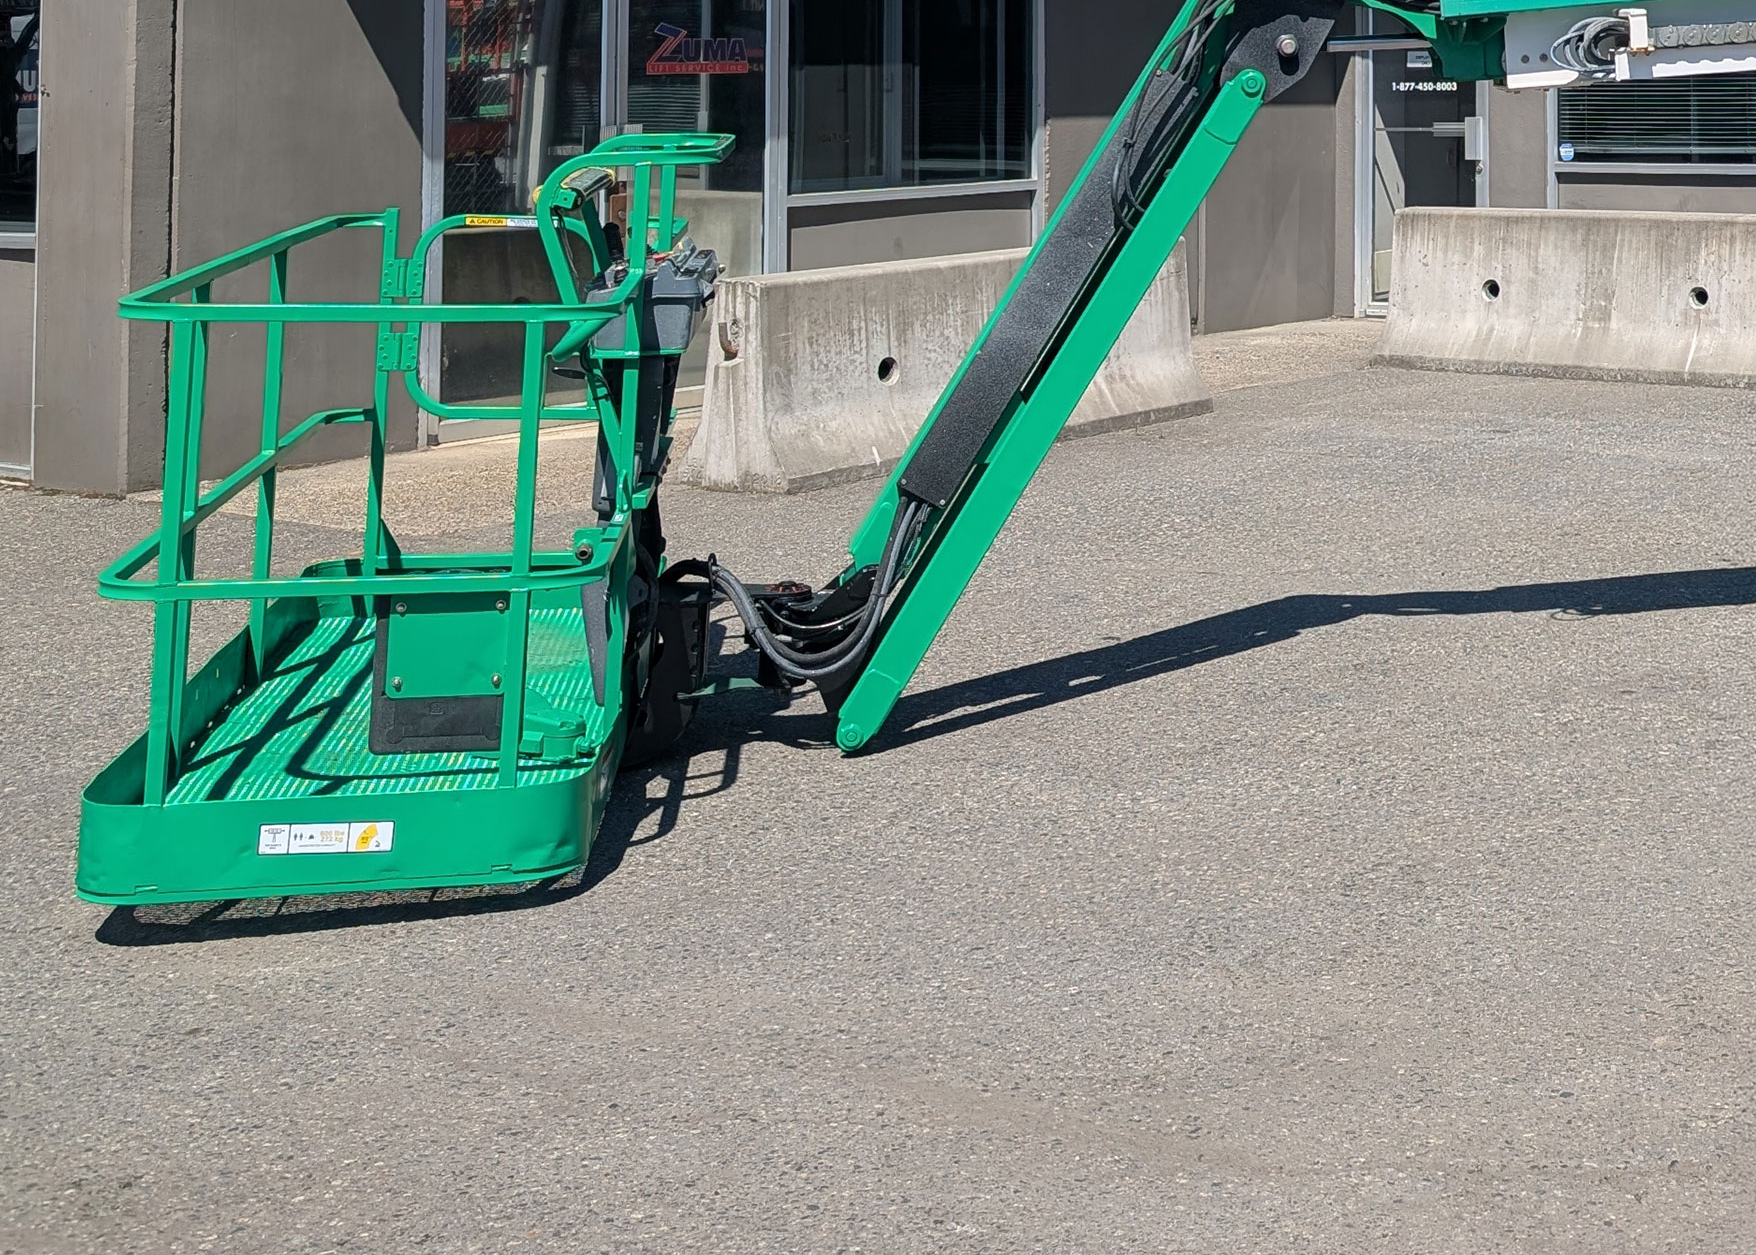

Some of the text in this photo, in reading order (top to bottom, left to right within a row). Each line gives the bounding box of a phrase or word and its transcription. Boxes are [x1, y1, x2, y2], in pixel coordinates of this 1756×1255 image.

[648, 22, 748, 62] ZUMA
[649, 63, 670, 73] LIFT
[675, 63, 721, 73] SERVICE
[1391, 82, 1458, 91] 1-877-450-8003
